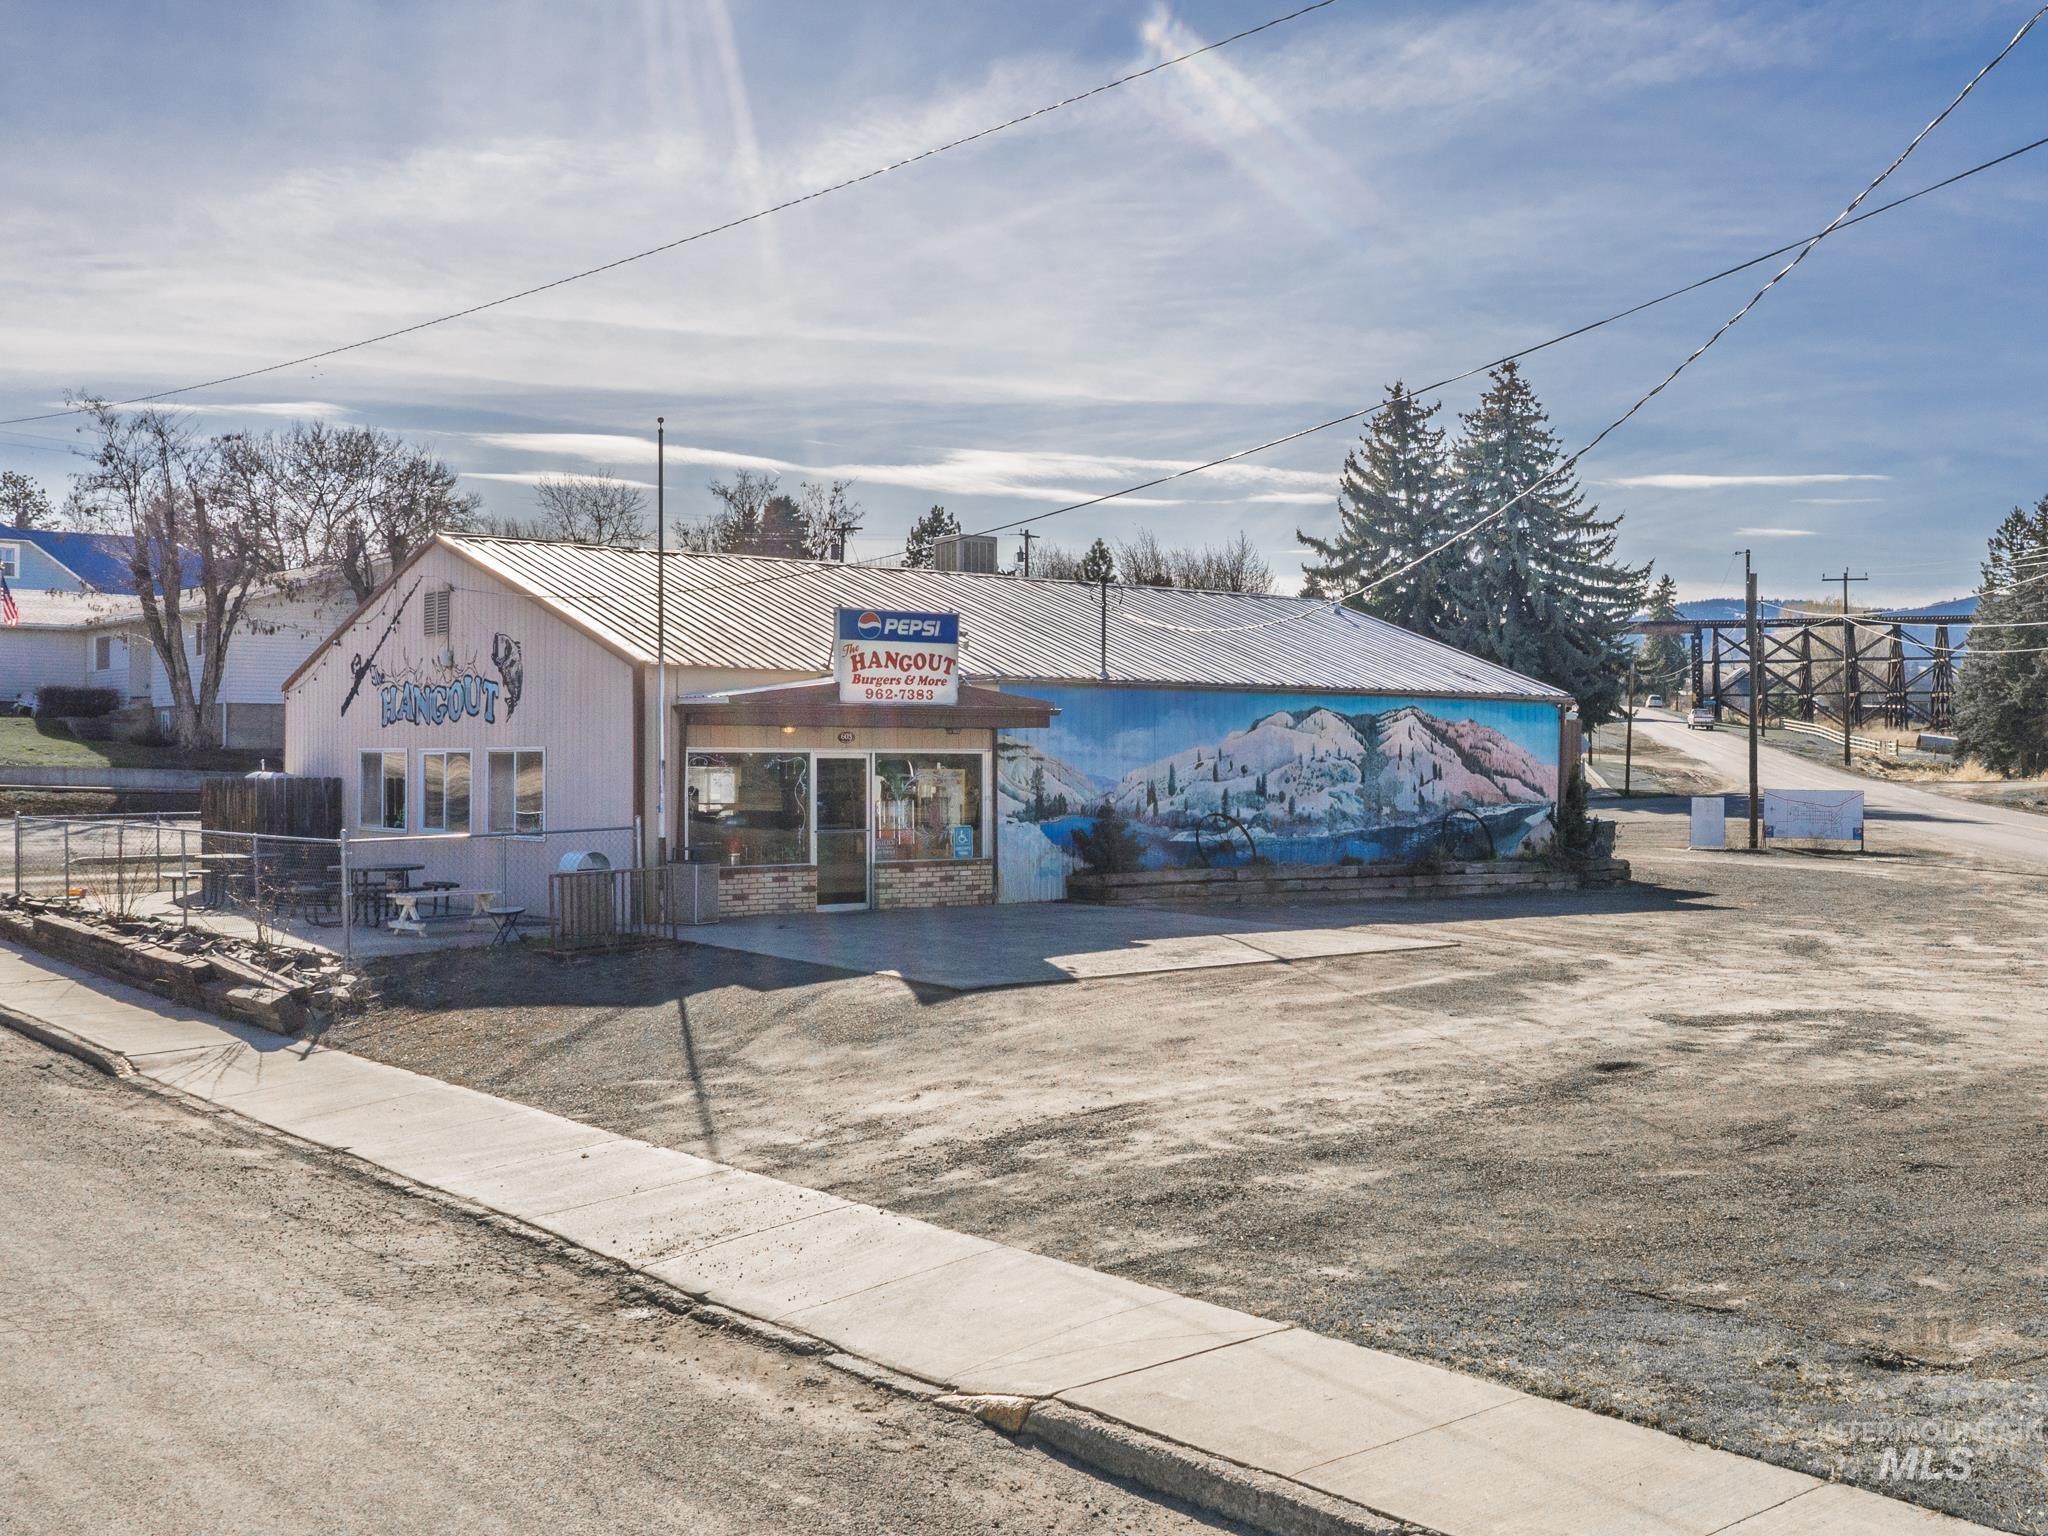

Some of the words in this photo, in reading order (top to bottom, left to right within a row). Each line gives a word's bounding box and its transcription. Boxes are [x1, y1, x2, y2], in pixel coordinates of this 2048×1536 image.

[884, 618, 942, 637] PEPSI
[842, 643, 860, 658] The
[850, 650, 957, 675] HANGOUT
[852, 673, 902, 687] Burgers
[904, 675, 916, 686] &
[917, 675, 948, 687] More
[381, 673, 499, 728] HANGOUT
[865, 688, 934, 701] 962-7383
